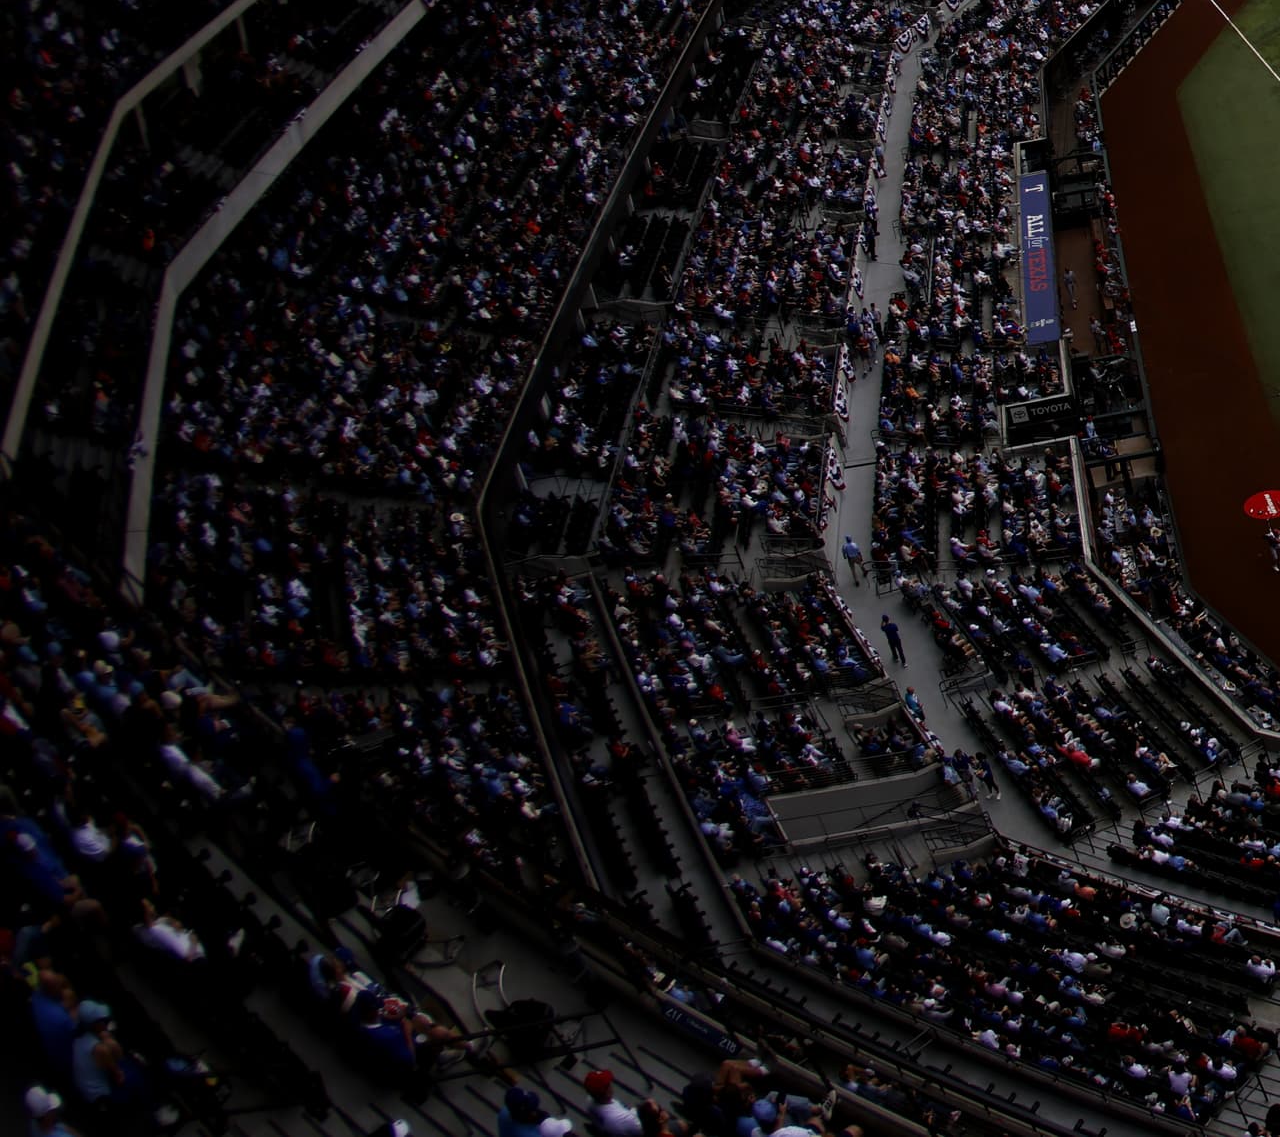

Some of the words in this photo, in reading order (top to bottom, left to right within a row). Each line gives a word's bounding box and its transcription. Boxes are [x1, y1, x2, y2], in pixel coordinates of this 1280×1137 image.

[1027, 214, 1044, 238] ALL
[1027, 236, 1049, 249] for
[1028, 246, 1049, 293] TEXAS
[1031, 402, 1071, 416] TOYOTA
